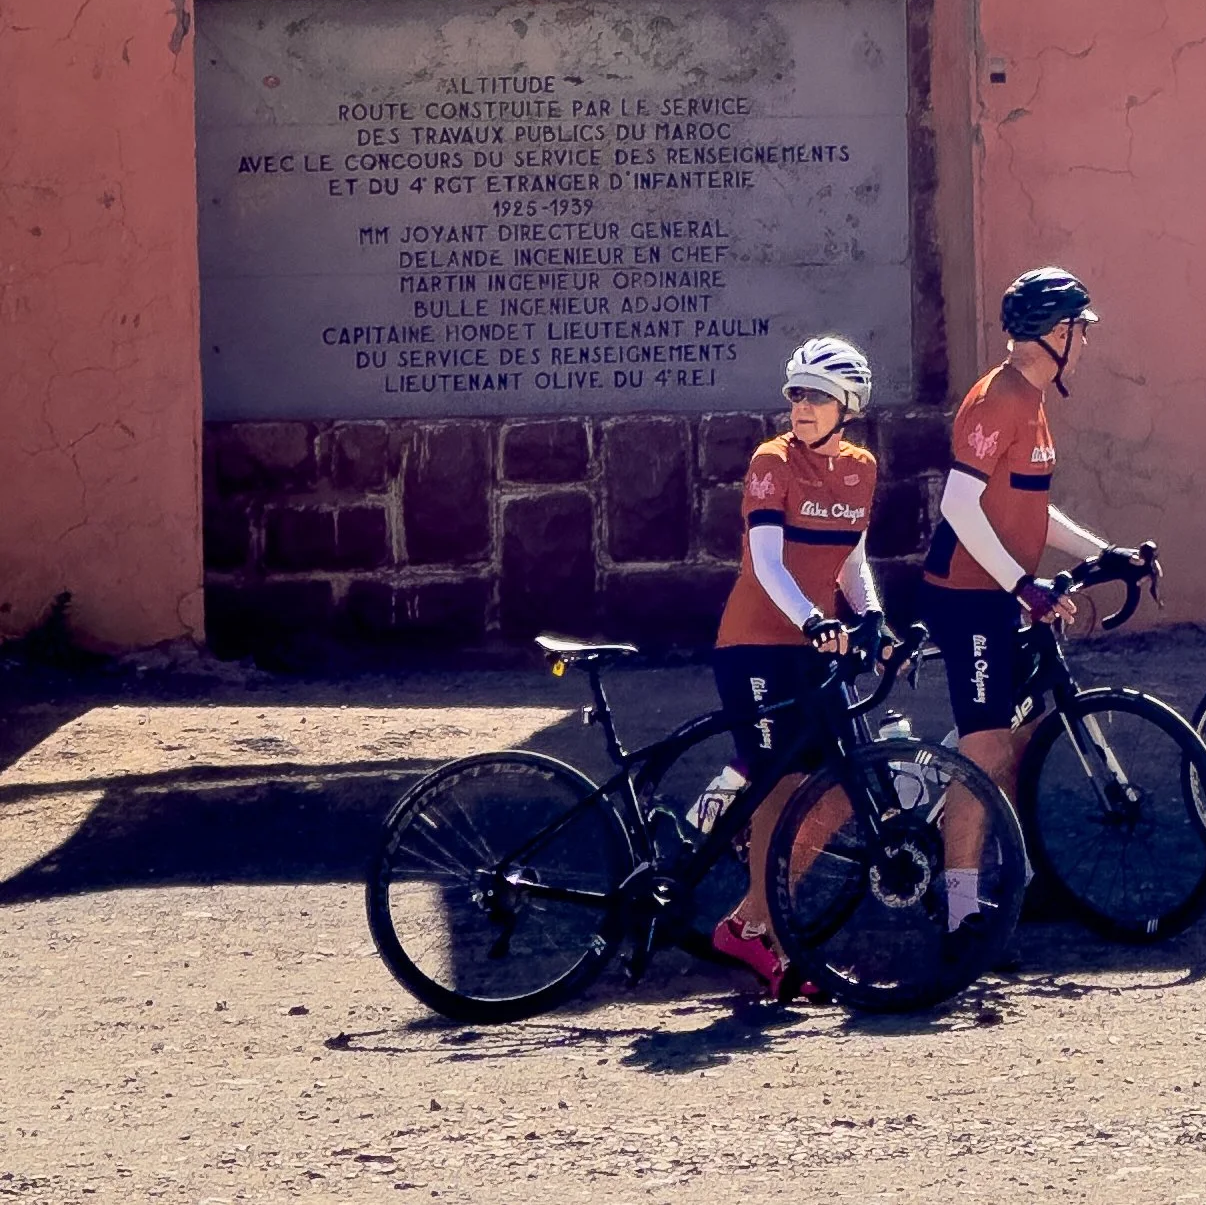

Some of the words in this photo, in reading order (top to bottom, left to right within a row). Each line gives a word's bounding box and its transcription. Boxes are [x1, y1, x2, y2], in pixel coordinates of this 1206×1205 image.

[446, 76, 555, 94] ALTITUDE
[338, 103, 414, 121] ROUTE
[425, 101, 561, 120] CONSTRUITE
[572, 99, 611, 117] PAR
[621, 99, 649, 117] LE
[660, 98, 751, 116] SERVICE
[357, 127, 400, 146] DES
[411, 126, 503, 145] TRAVAUX
[515, 124, 605, 143] PUBLICS
[616, 123, 646, 141] DU
[655, 122, 731, 141] MAROC
[238, 155, 294, 173] AVEC
[304, 155, 334, 172] LE
[344, 151, 463, 172] CONCOURS
[474, 150, 503, 168] DU
[514, 148, 601, 168] SERVICE
[614, 147, 655, 166] DES
[667, 145, 850, 166] RENSEIGNEMENTS
[329, 178, 357, 196] ET
[369, 177, 399, 194] DU
[434, 176, 476, 193] RGT
[486, 174, 600, 193] ETRANGER
[610, 170, 755, 190] D'INFANTERIE
[493, 198, 593, 218] 1925-1939
[359, 226, 390, 244] MM
[400, 224, 488, 243] JOYANT
[499, 222, 619, 242] DIRECTEUR
[630, 219, 729, 239] GENERAL
[399, 249, 502, 269] DELANDE
[514, 247, 623, 267] INGENIEUR
[634, 246, 661, 264] EN
[671, 245, 730, 263] CHEF
[400, 274, 475, 293] MARTIN
[488, 272, 600, 292] INGENIEUR
[613, 270, 726, 290] ORDINAIRE
[414, 299, 488, 318] BULLE
[501, 297, 609, 316] INGENIEUR
[621, 295, 713, 314] ADJOINT
[322, 325, 435, 345] CAPITAINE
[445, 323, 536, 342] HONDET
[548, 320, 685, 340] LIEUTENANT
[695, 318, 770, 336] PAULIN
[356, 350, 386, 369] DU
[397, 348, 489, 368] SERVICE
[500, 347, 540, 366] DES
[552, 344, 737, 365] RENSEIGNEMENTS
[385, 372, 523, 393] LIEUTENANT
[535, 370, 601, 390] OLIVE
[614, 370, 643, 388] DU
